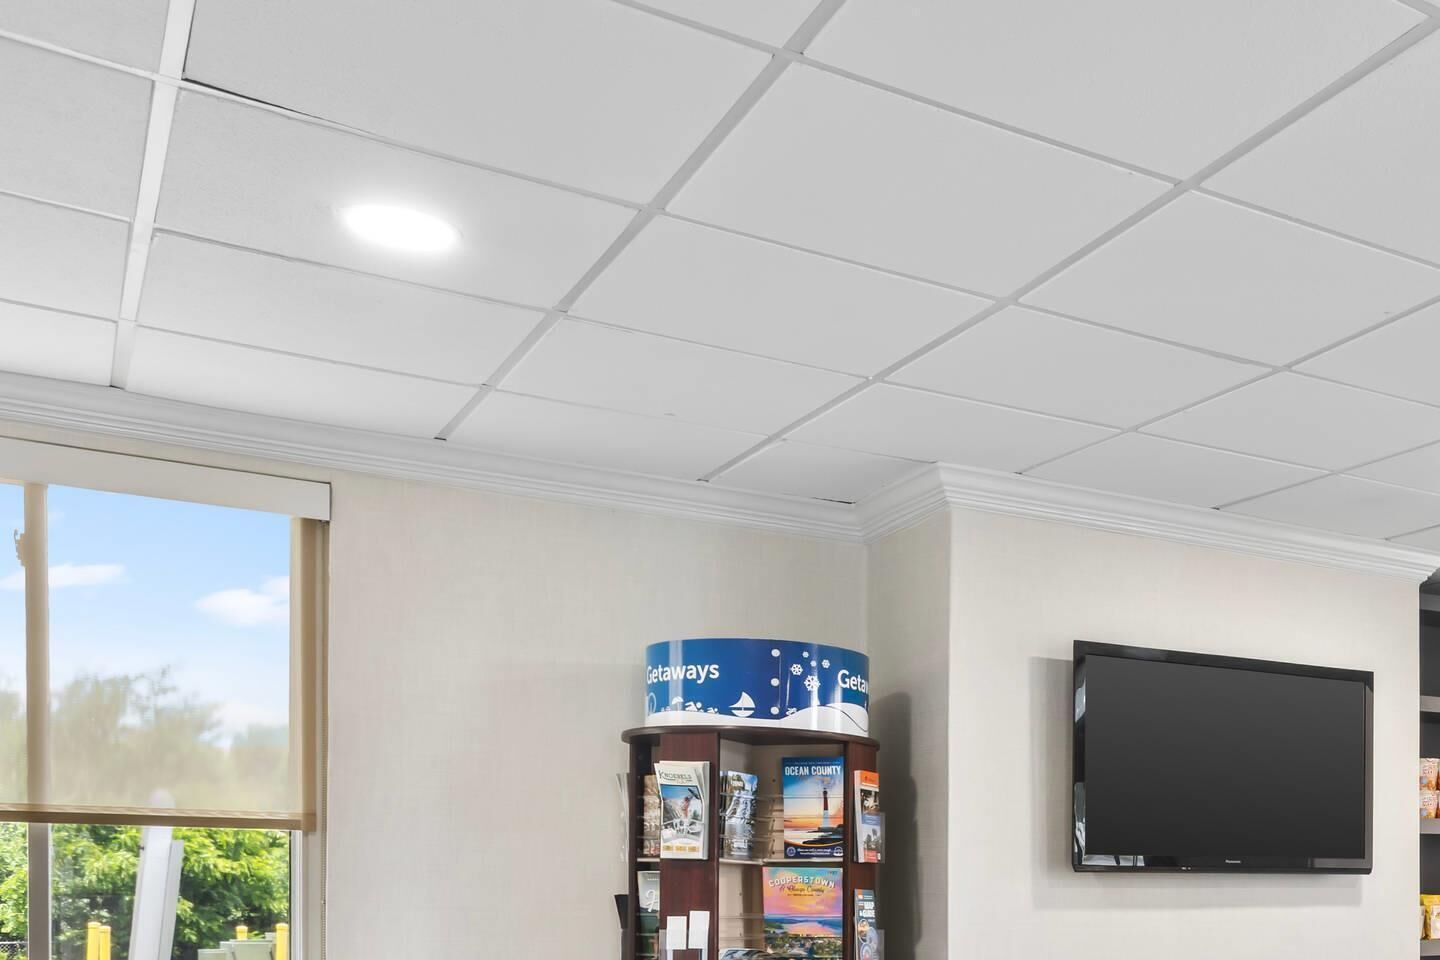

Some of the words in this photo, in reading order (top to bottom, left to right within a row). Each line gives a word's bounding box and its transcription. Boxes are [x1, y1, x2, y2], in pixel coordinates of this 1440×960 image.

[646, 661, 720, 685] Getaways
[837, 669, 870, 694] Geta
[784, 766, 810, 776] OCEAN
[811, 765, 841, 776] COUNTY
[768, 875, 836, 889] COOPERSTOWN
